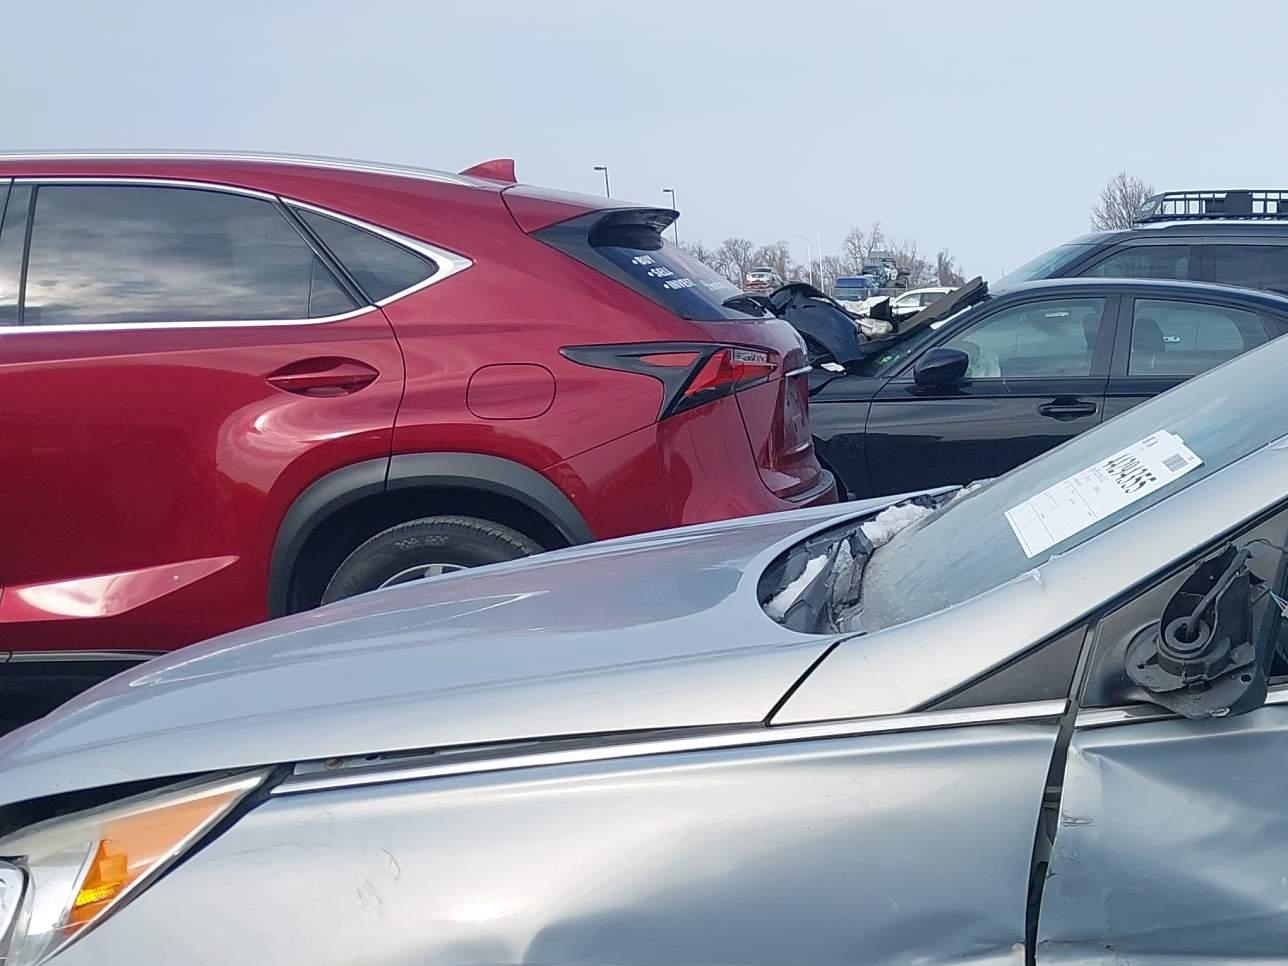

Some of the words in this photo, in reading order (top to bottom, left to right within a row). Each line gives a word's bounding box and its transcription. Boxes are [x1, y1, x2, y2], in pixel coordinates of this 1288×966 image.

[637, 254, 656, 266] BUY
[650, 266, 675, 278] SELL
[667, 277, 696, 290] INVEST
[1102, 452, 1158, 494] 44294355
